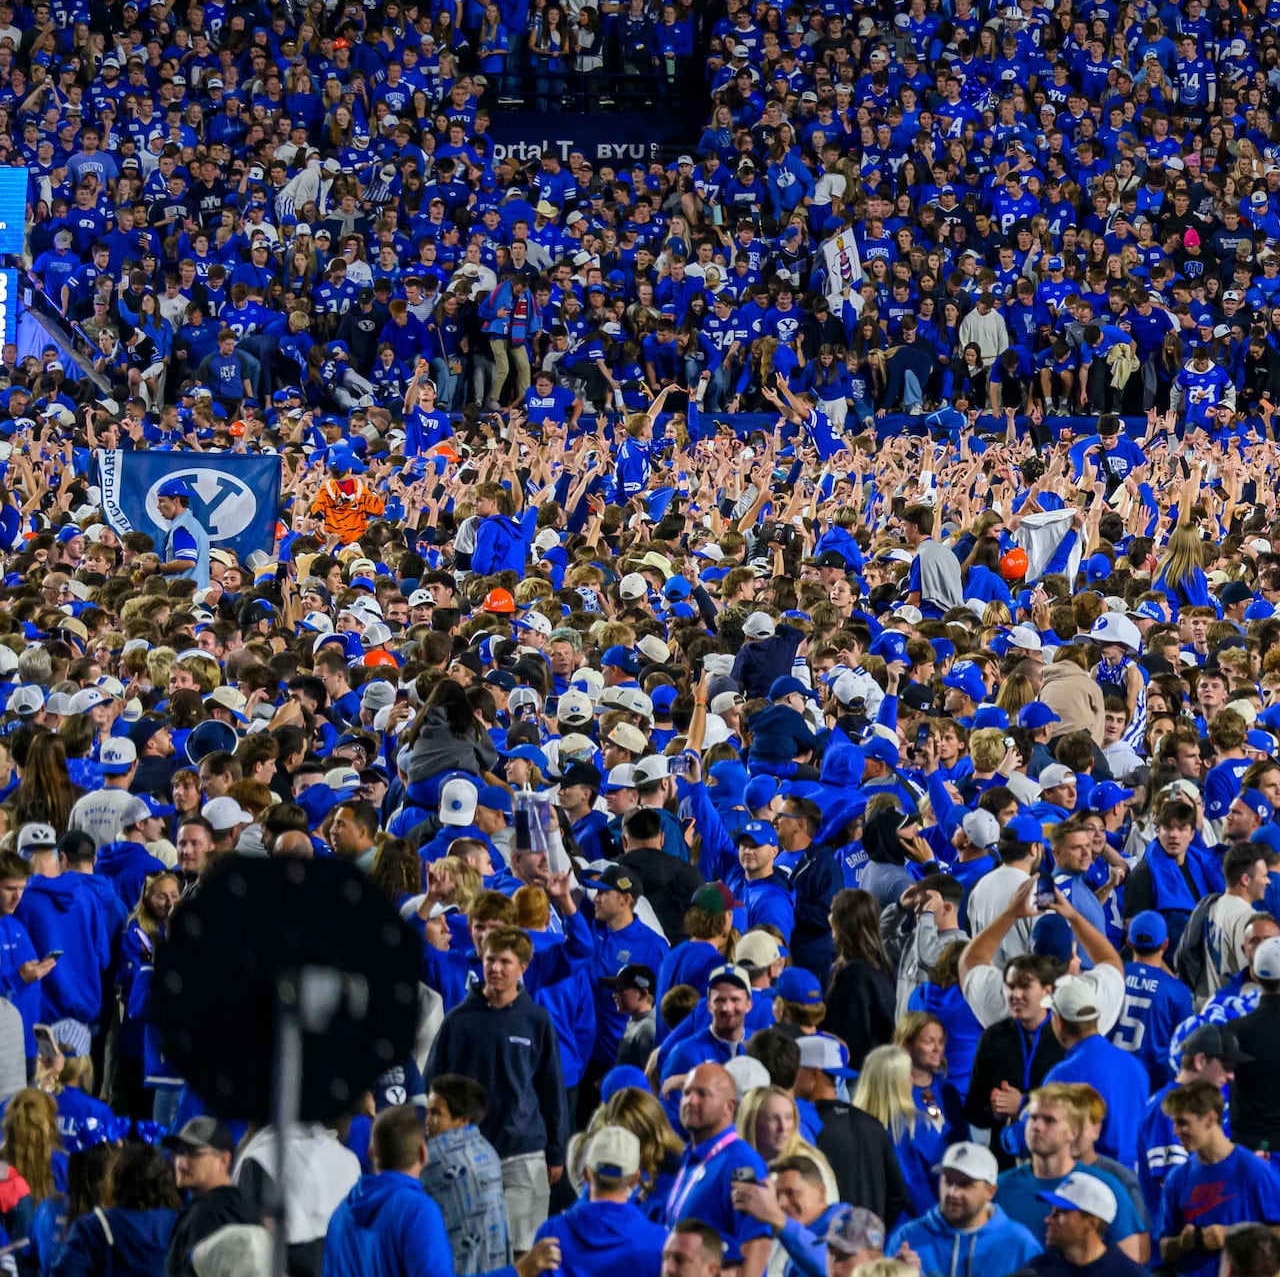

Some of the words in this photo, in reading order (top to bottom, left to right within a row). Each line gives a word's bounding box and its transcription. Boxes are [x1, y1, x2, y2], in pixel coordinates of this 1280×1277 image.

[449, 114, 471, 124] BYU
[493, 140, 548, 161] ortal
[556, 141, 574, 161] T
[597, 144, 645, 160] BYU
[200, 194, 221, 208] BYU
[712, 331, 734, 350] 34
[103, 750, 122, 762] BYU
